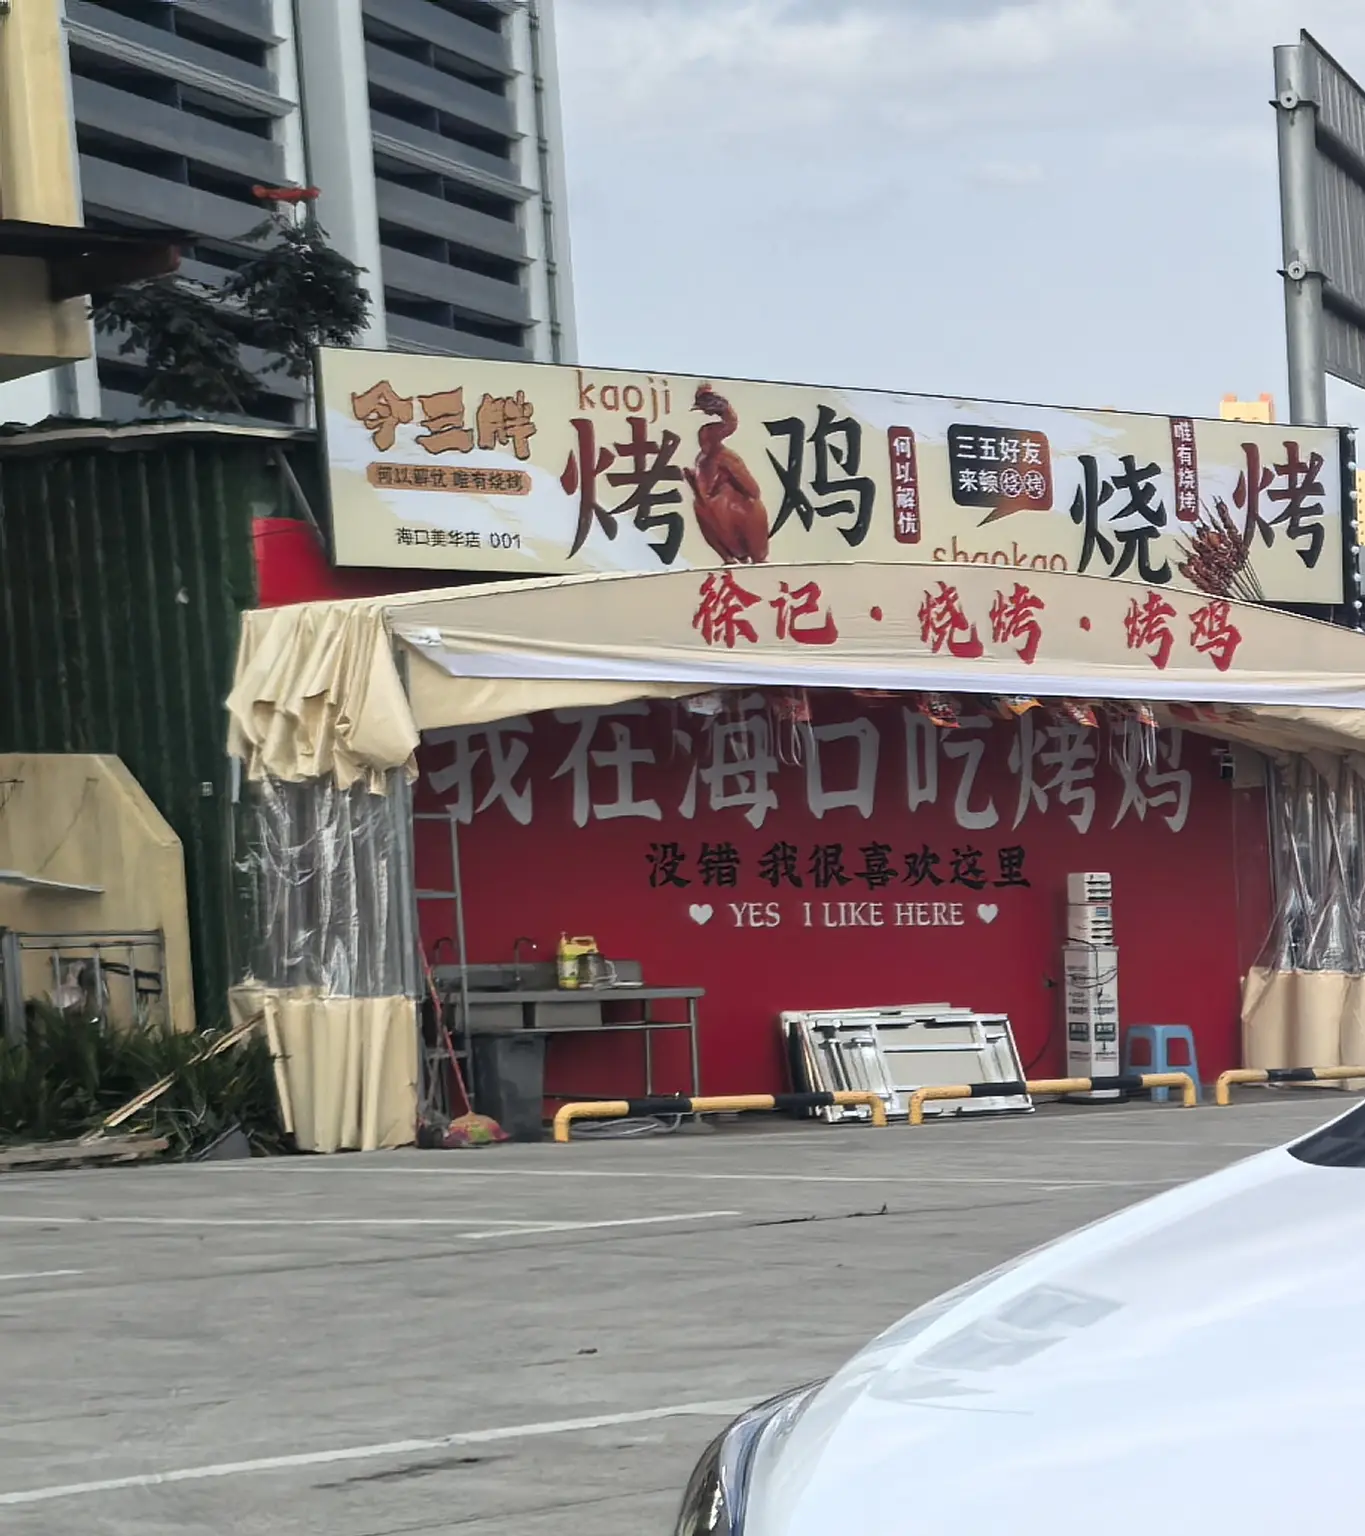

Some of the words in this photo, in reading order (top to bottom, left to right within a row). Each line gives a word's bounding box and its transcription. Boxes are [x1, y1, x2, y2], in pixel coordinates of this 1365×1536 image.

[577, 369, 671, 423] kaoji
[956, 435, 1043, 465] 三五好友
[1173, 421, 1197, 514] 唯有烧烤
[892, 435, 919, 534] 何以解忧
[395, 526, 482, 549] 海口美华店
[489, 532, 521, 549] 001
[644, 841, 741, 889] 没错
[757, 840, 1032, 891] 我很喜欢这里
[728, 902, 781, 928] YES
[802, 902, 813, 928] I
[820, 902, 885, 928] LIKE
[893, 901, 966, 927] HERE
